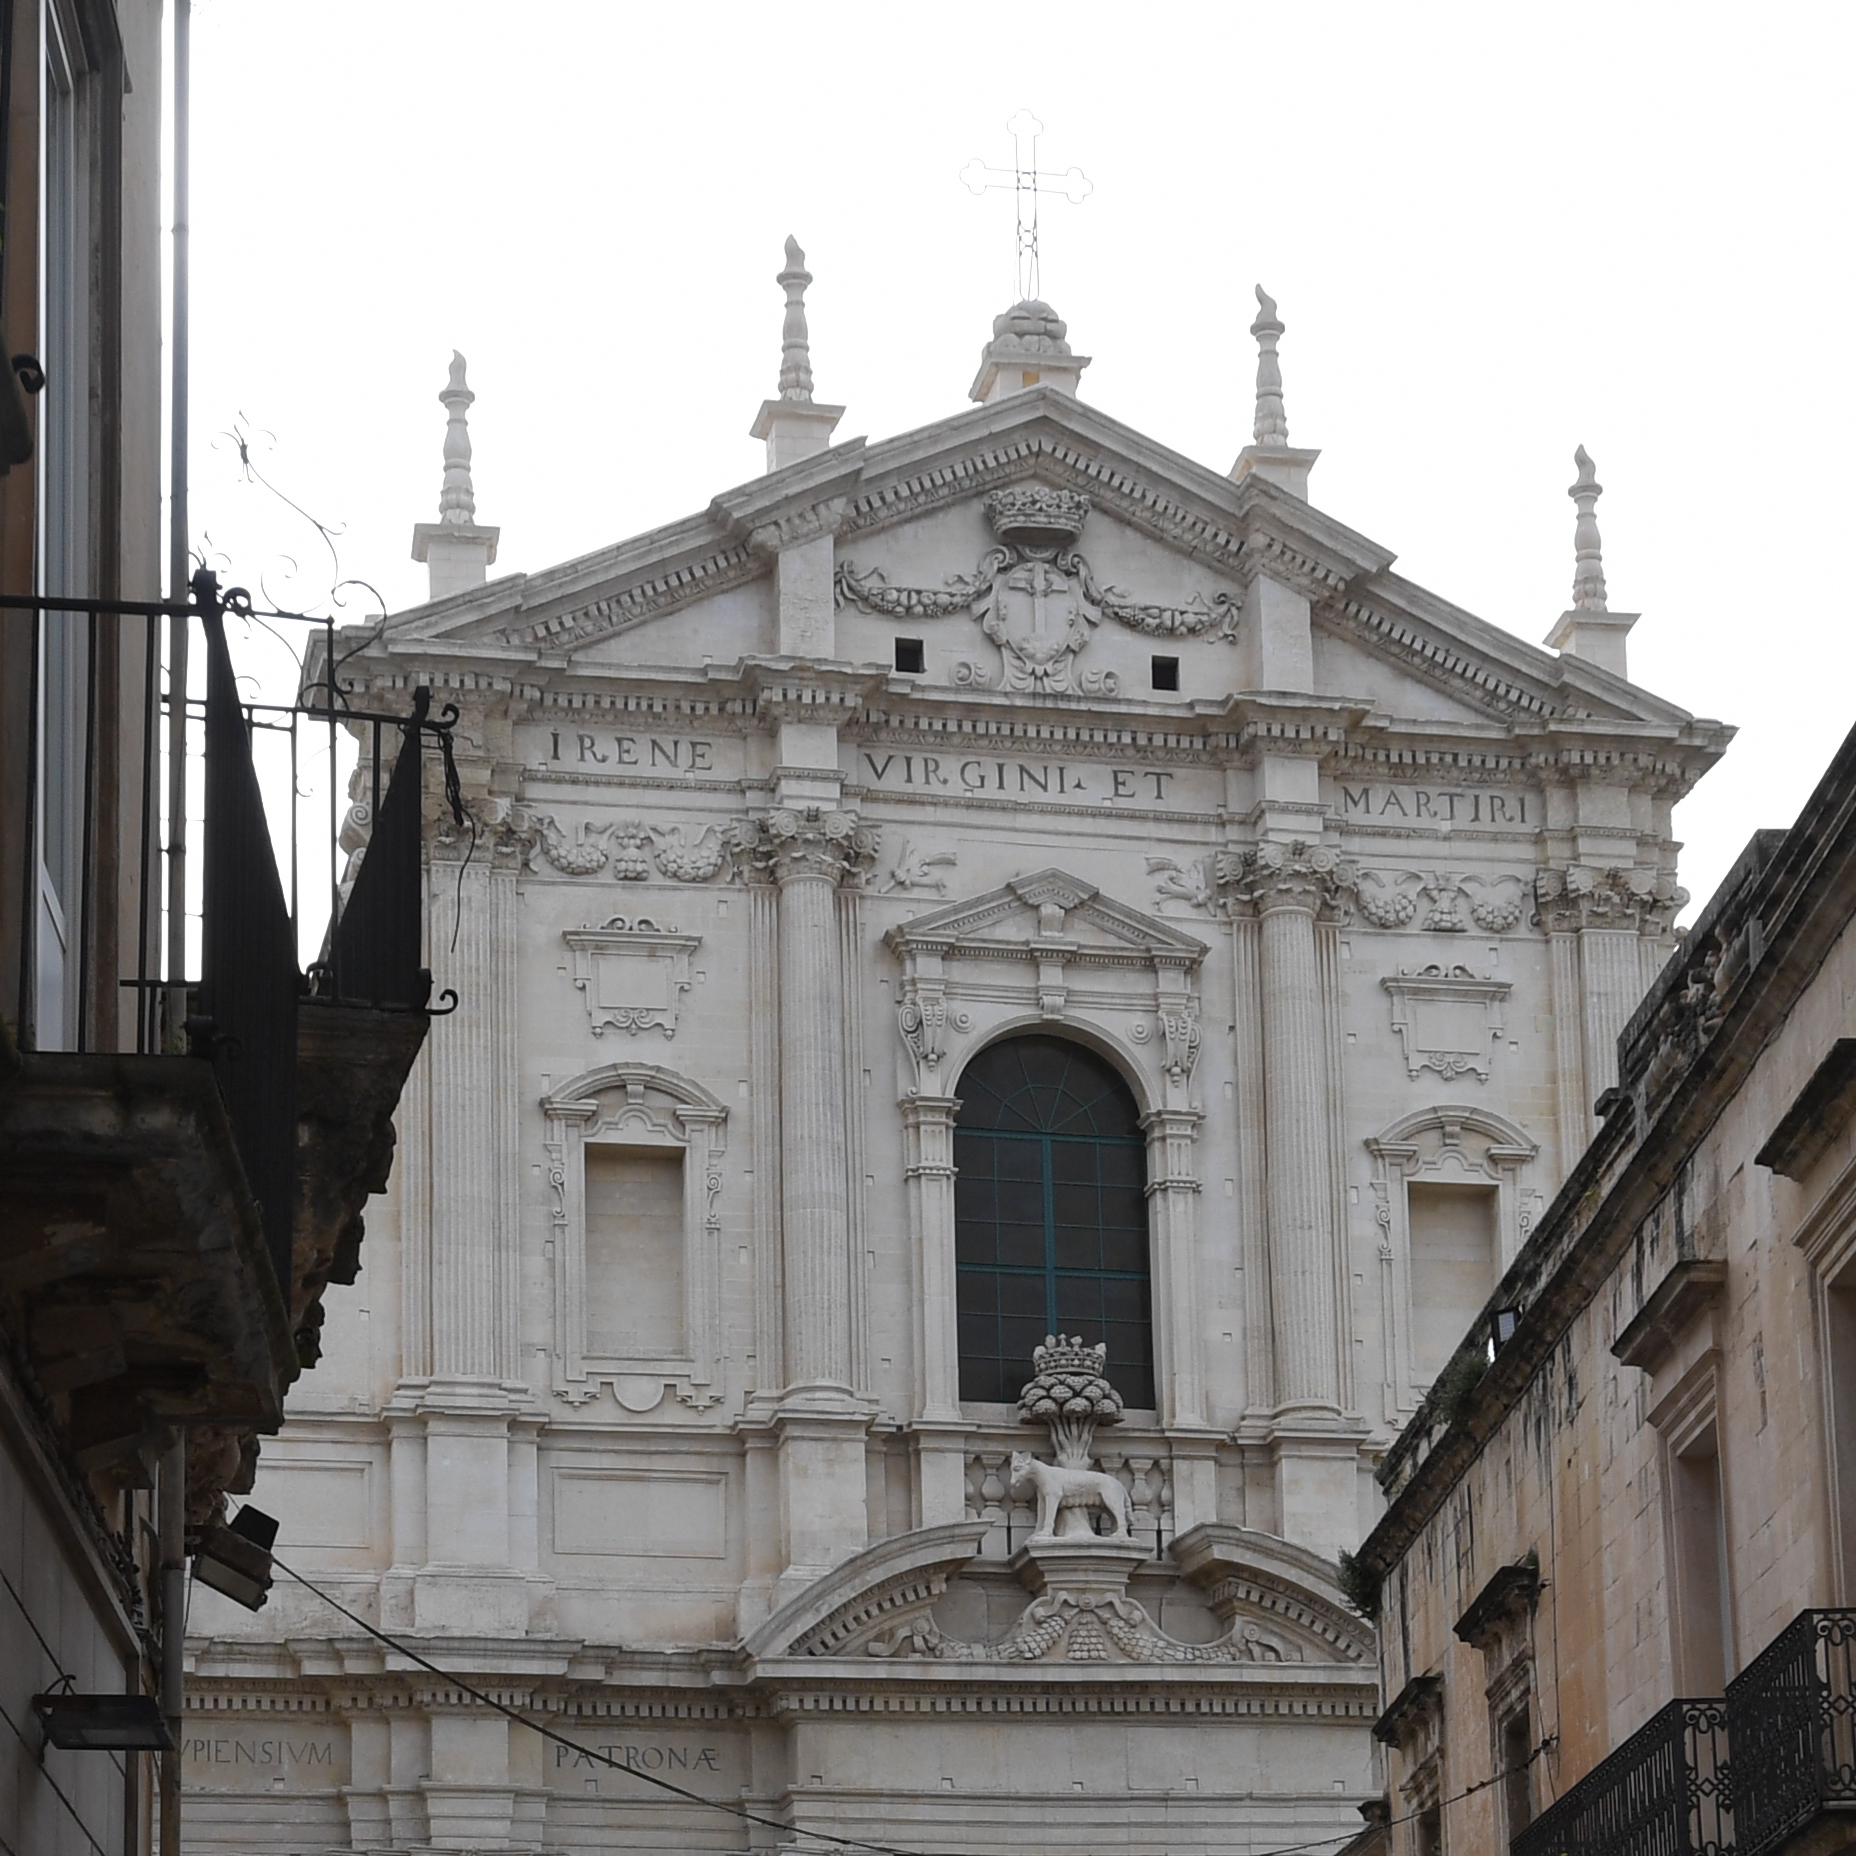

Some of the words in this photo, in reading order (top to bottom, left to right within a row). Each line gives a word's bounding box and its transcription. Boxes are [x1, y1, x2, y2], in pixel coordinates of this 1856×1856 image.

[550, 731, 713, 771] IRENE
[1111, 769, 1174, 800] ET
[1341, 786, 1527, 824] MARTIRI
